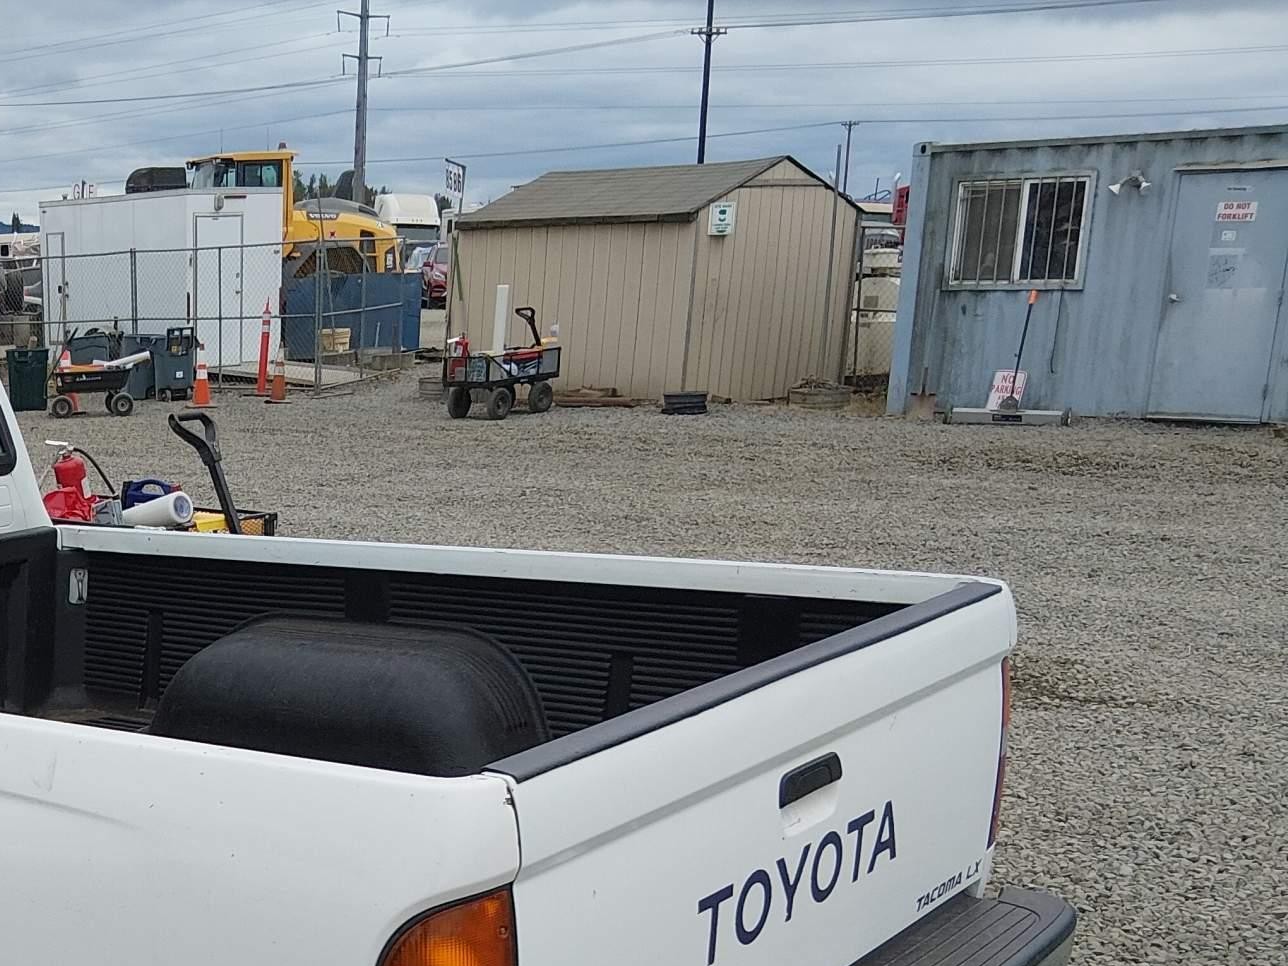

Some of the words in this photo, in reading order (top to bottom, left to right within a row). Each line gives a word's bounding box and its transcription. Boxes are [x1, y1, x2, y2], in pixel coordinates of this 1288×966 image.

[1236, 202, 1252, 210] NOT
[1217, 212, 1255, 220] FORKLIFT
[991, 384, 1023, 396] PARKIG
[697, 800, 897, 966] TOYOTA
[916, 871, 963, 913] TACOMA
